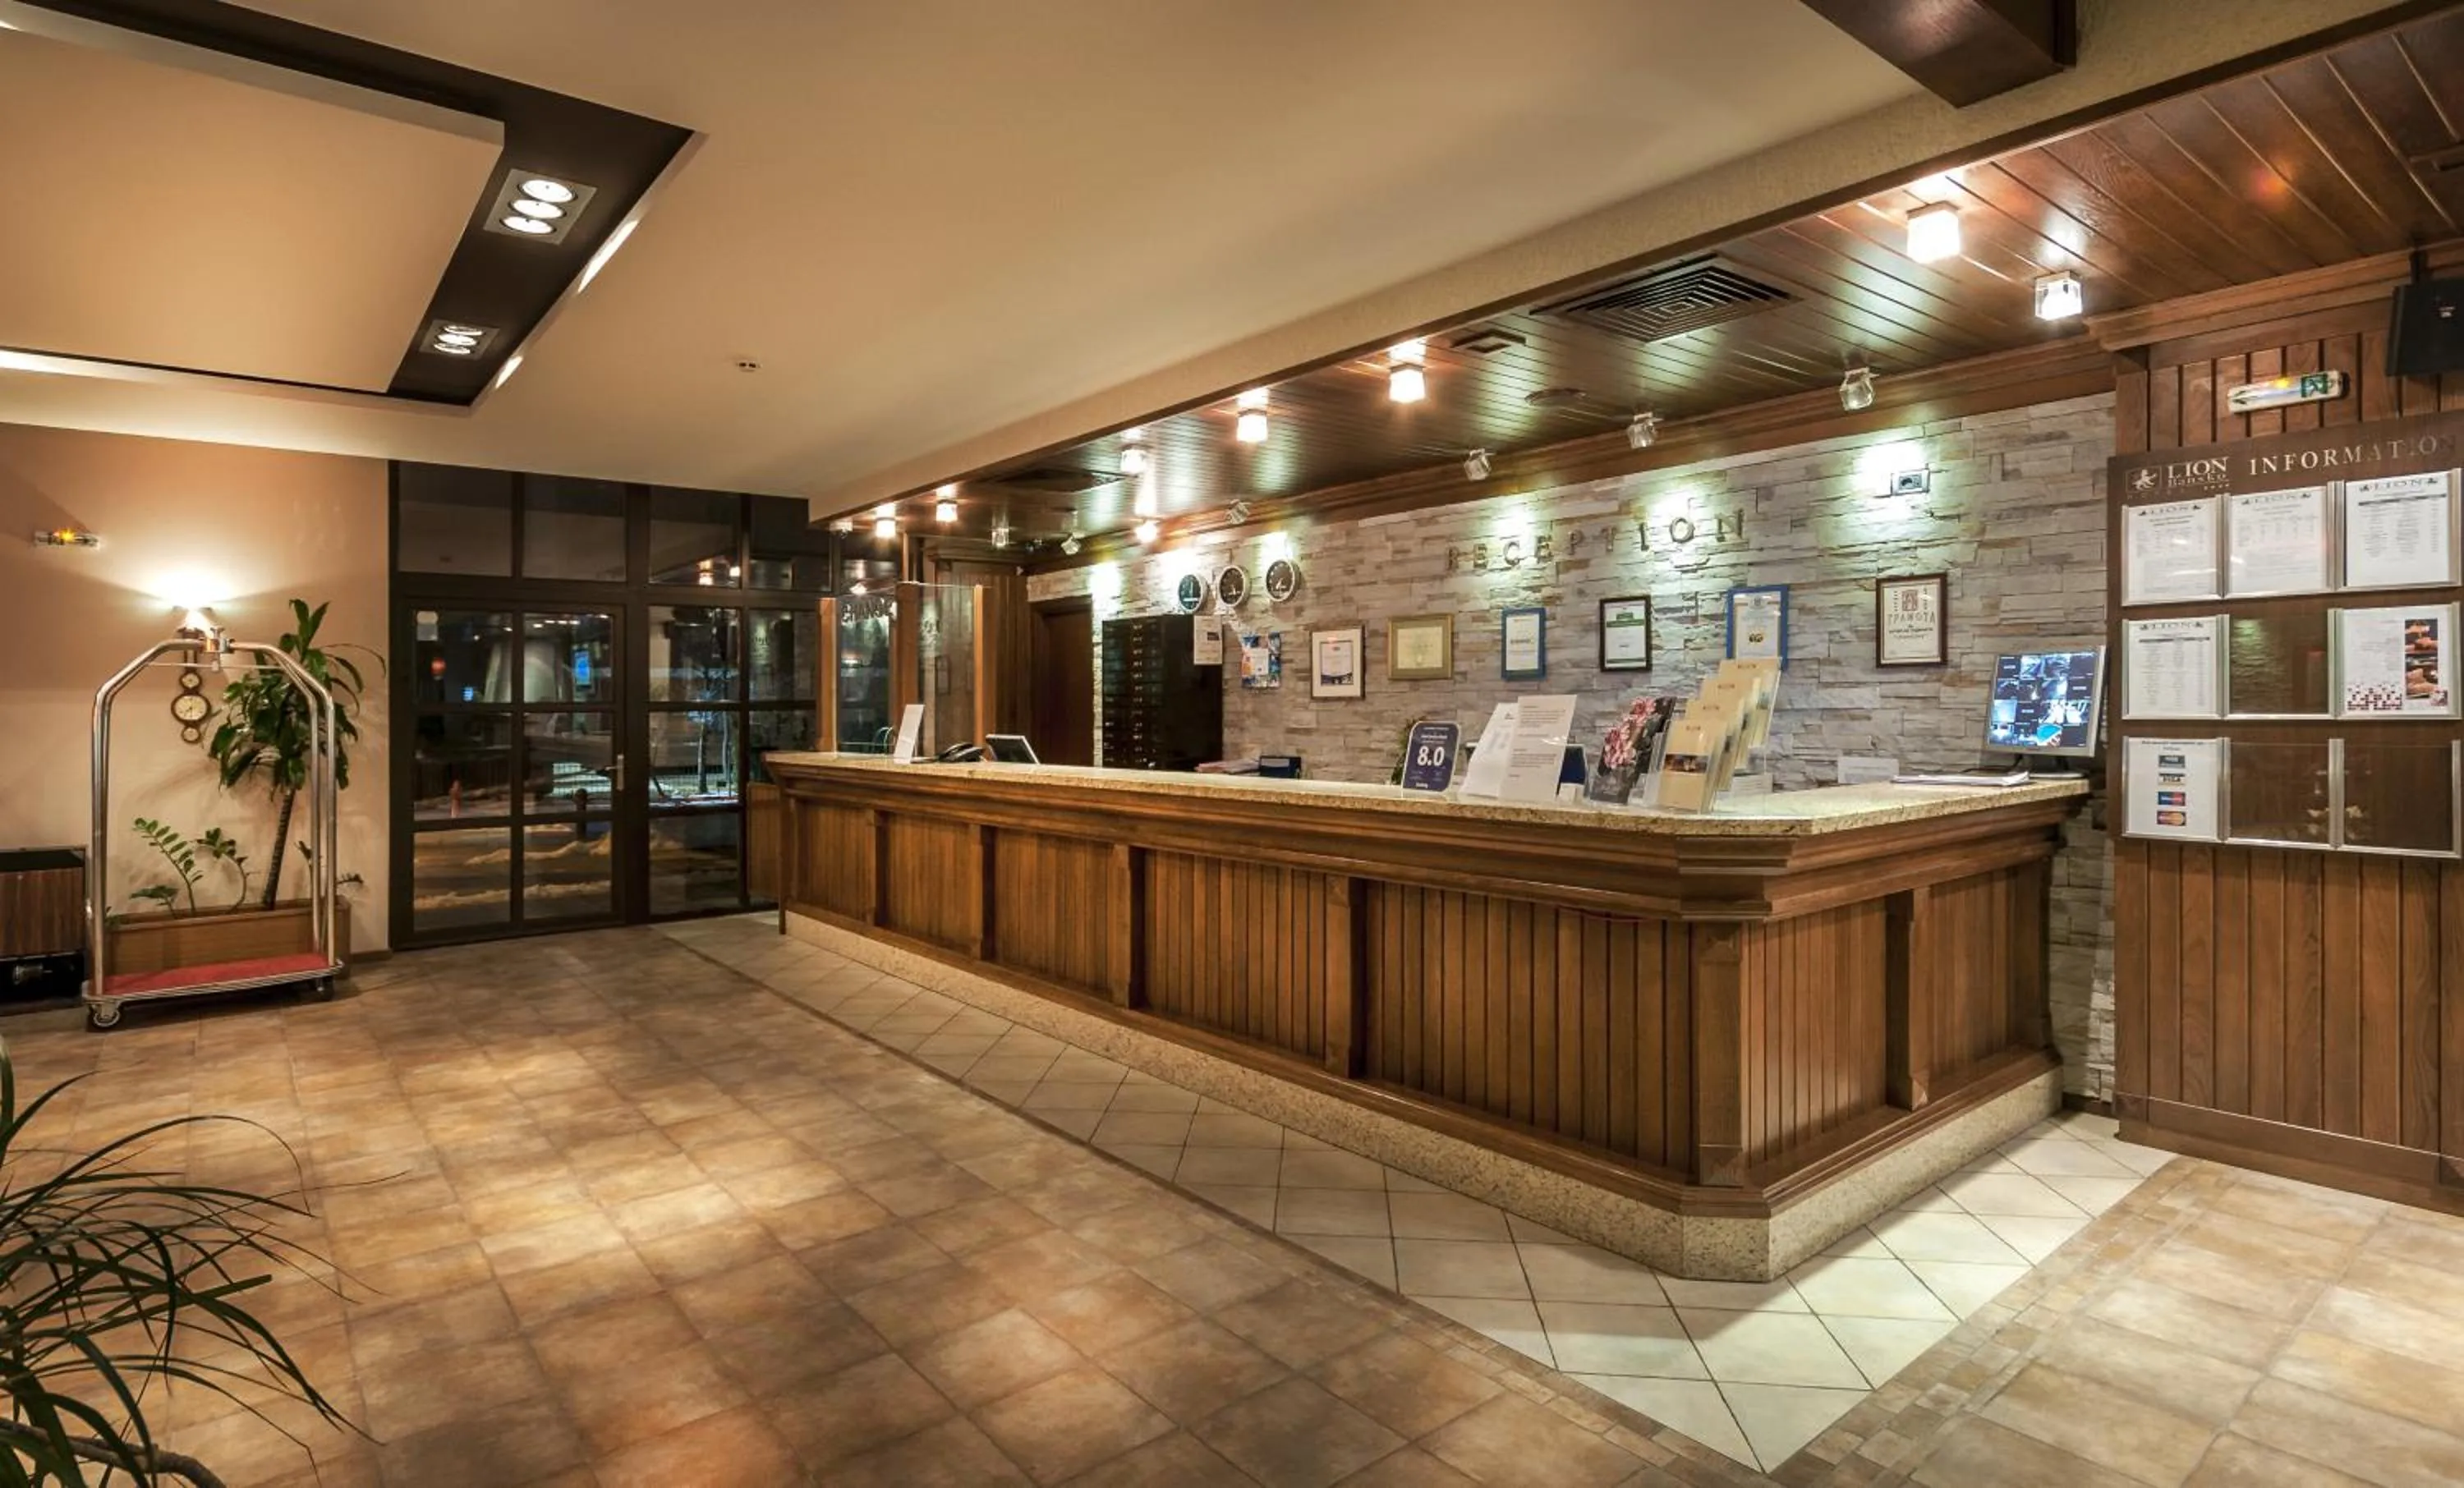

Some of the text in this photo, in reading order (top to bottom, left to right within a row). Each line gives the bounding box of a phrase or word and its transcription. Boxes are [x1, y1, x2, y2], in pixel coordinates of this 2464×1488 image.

[2167, 456, 2230, 480] LION
[1446, 507, 1745, 572] RECEPTION
[1418, 746, 1445, 766] 8.0
